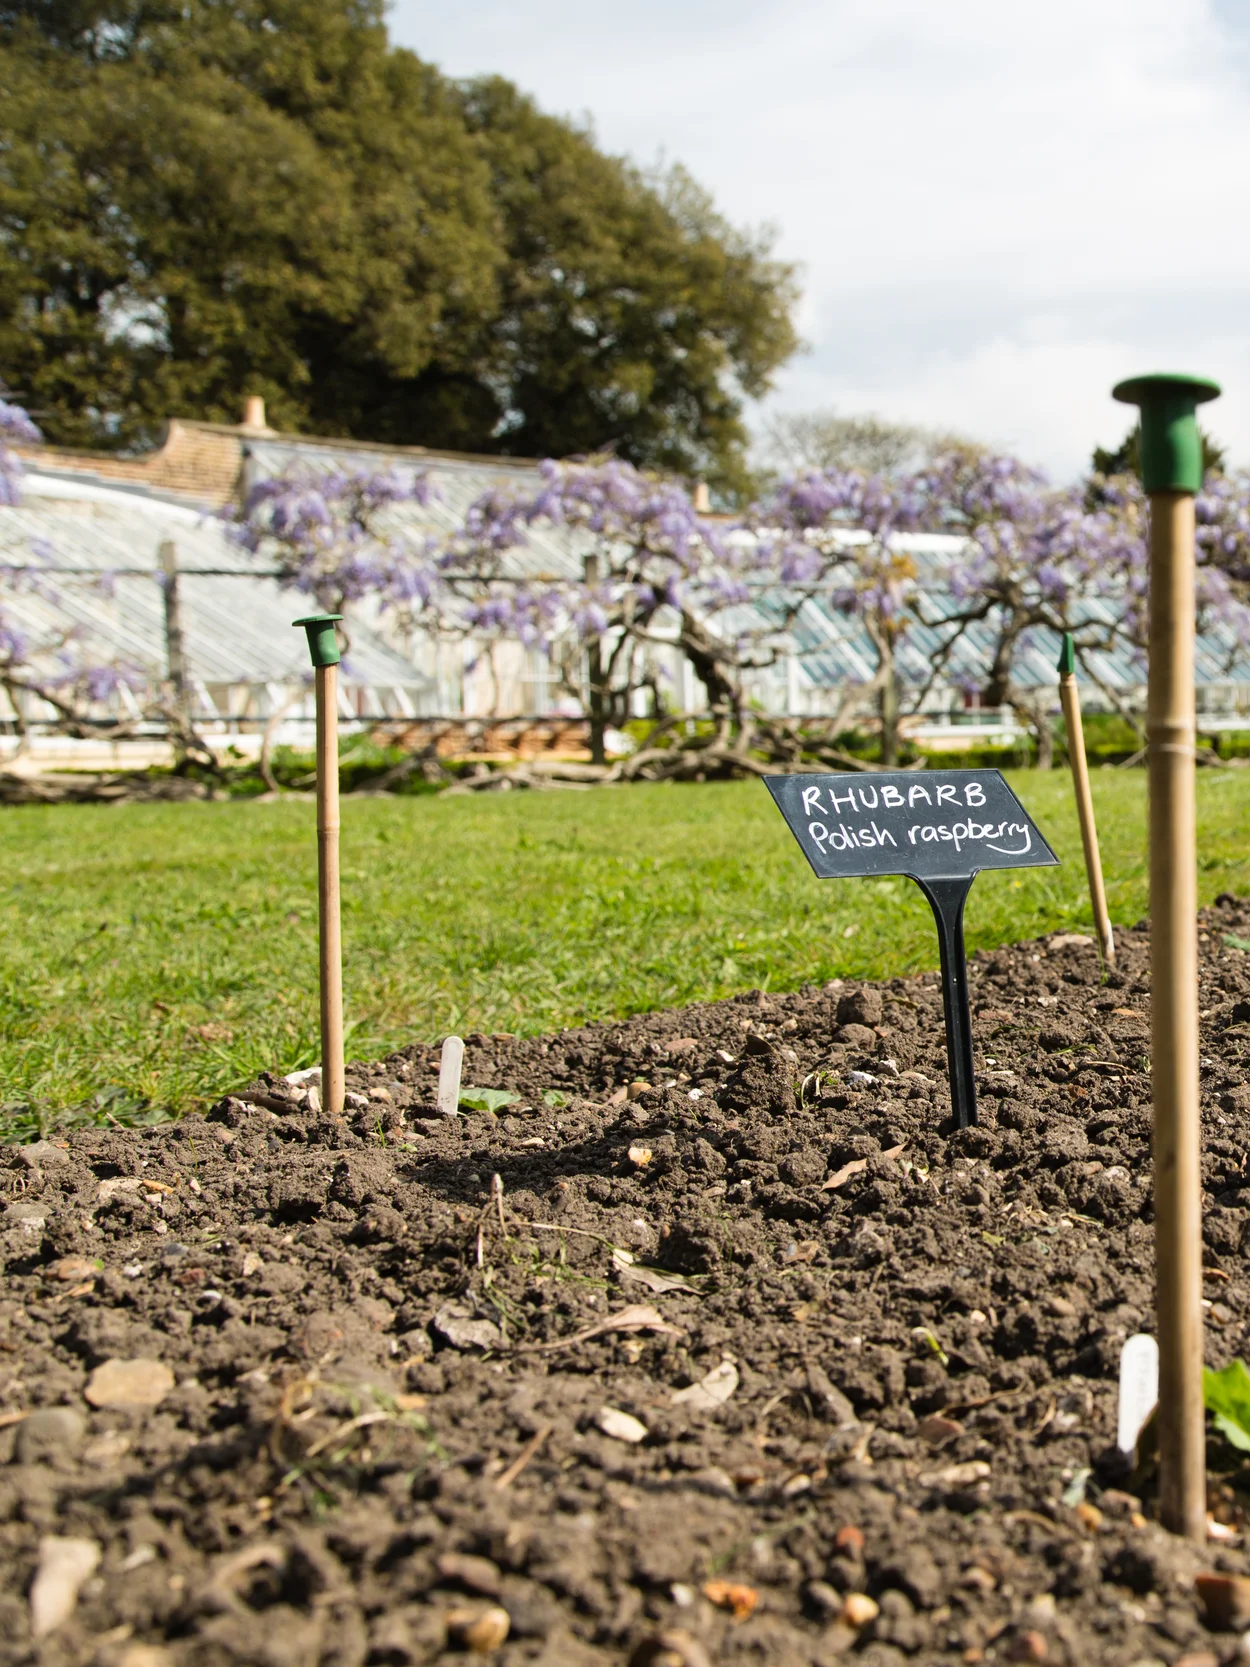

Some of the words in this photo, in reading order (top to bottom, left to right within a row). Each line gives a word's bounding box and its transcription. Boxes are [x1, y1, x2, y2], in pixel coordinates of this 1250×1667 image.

[801, 782, 987, 816] RHUBARB
[808, 821, 898, 855] Polish
[907, 817, 1032, 855] raspberry
